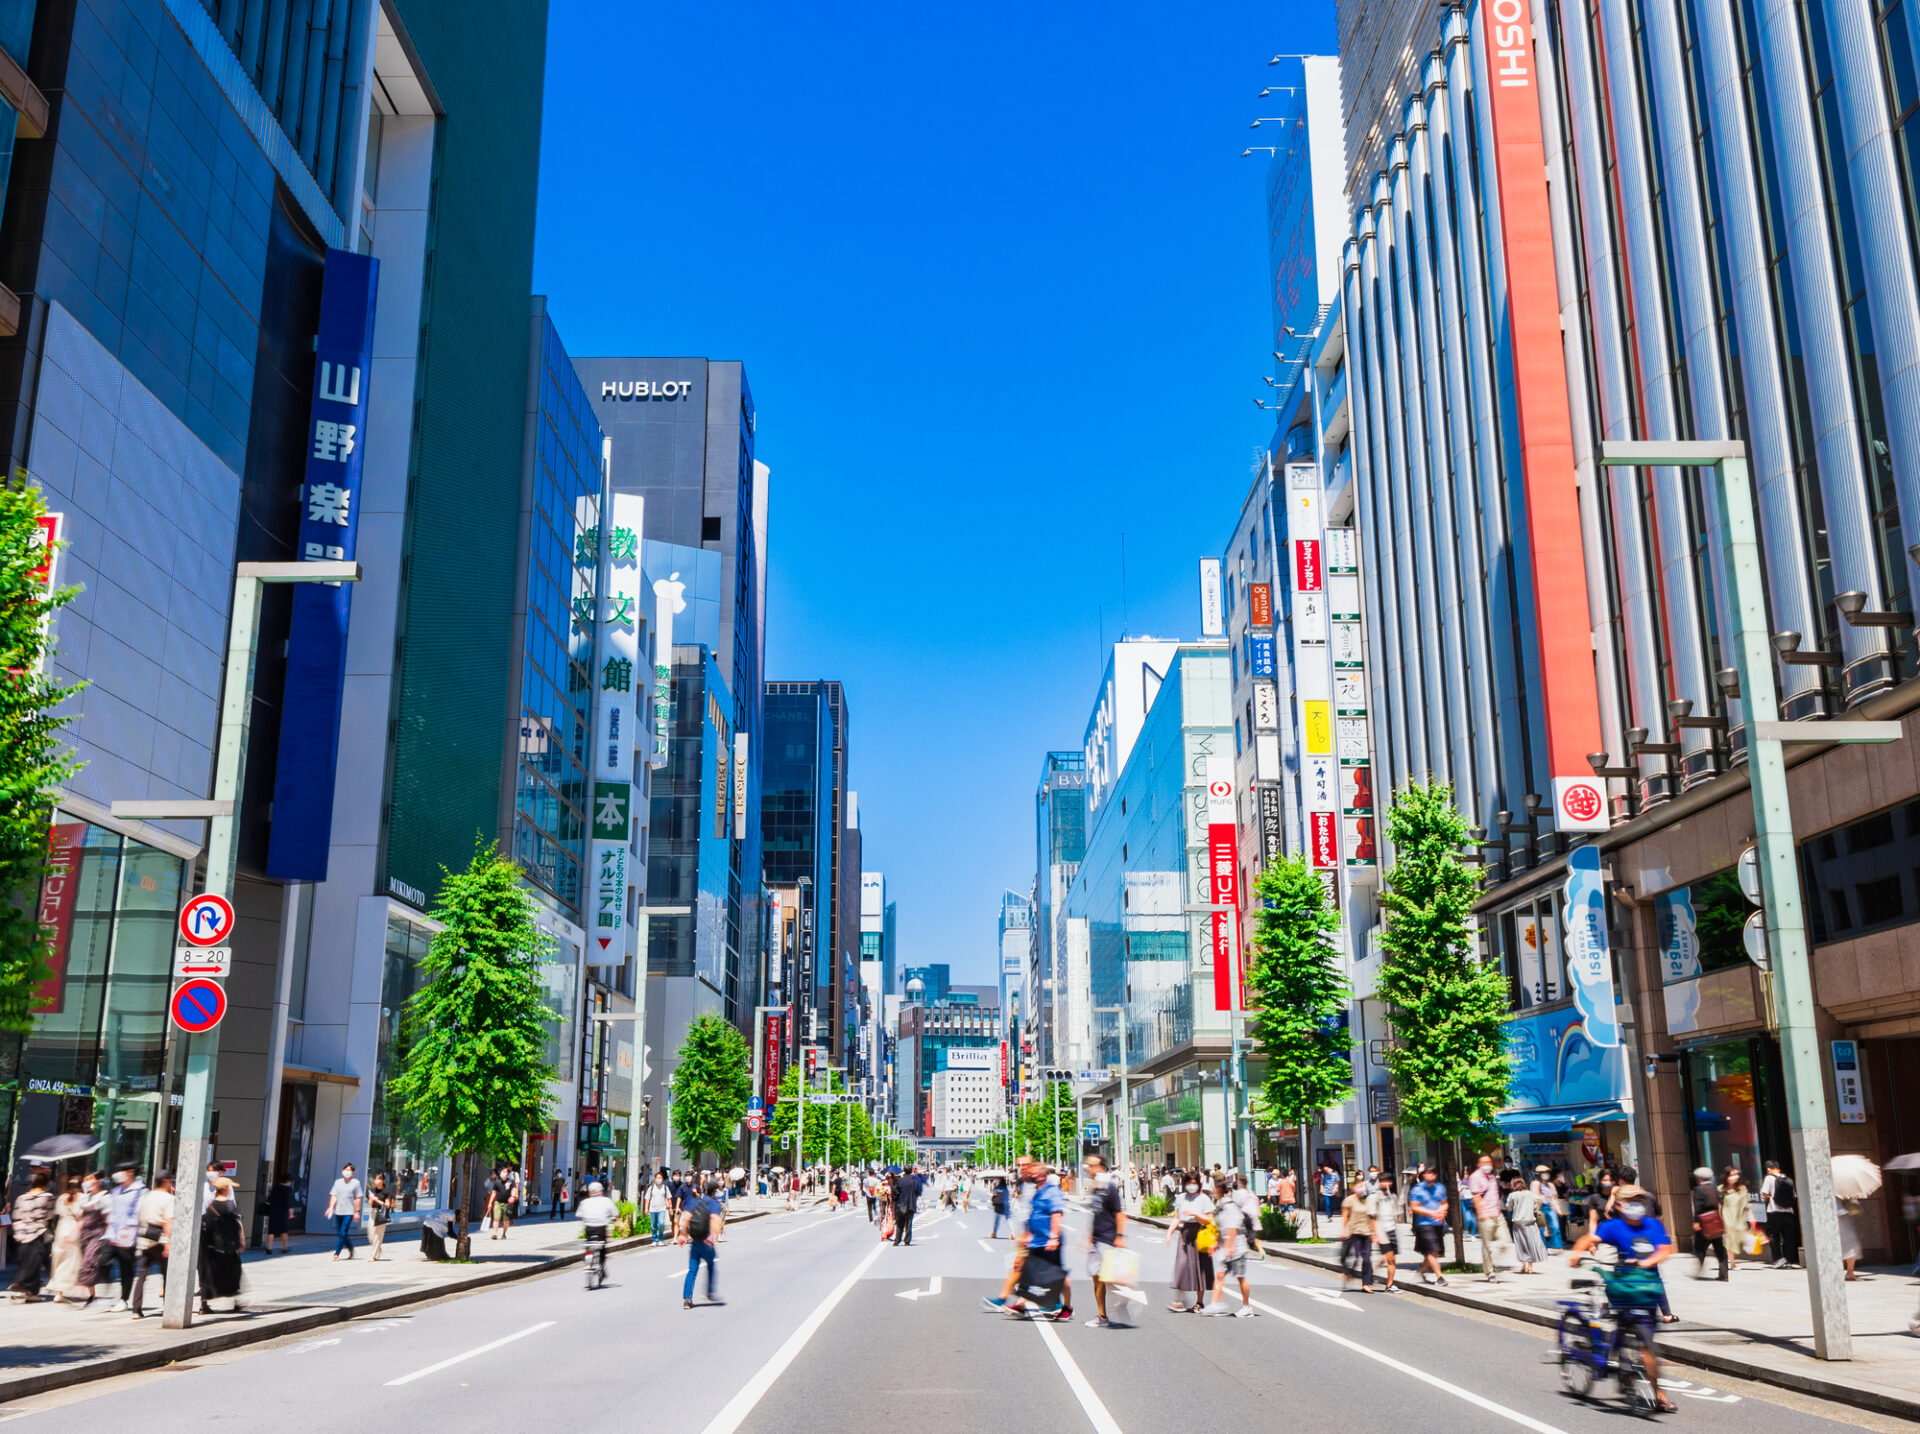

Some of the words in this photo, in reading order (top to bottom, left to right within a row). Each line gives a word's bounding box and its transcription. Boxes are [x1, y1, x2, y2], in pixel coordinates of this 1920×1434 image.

[601, 381, 692, 397] HUBLOT
[602, 526, 638, 693] 教文館
[654, 664, 671, 756] 教文館ビル
[764, 711, 810, 720] CHANEL
[1259, 686, 1270, 723] ざくろ
[610, 707, 621, 741] SINCE
[595, 792, 626, 831] 本
[1210, 798, 1233, 806] MUFG
[1318, 816, 1330, 864] おたからや
[389, 876, 426, 907] MIKIMOTO
[598, 850, 616, 928] ナルニア国
[1578, 930, 1587, 960] GINZA
[951, 1052, 988, 1061] Brillia
[28, 1078, 51, 1091] GINZA
